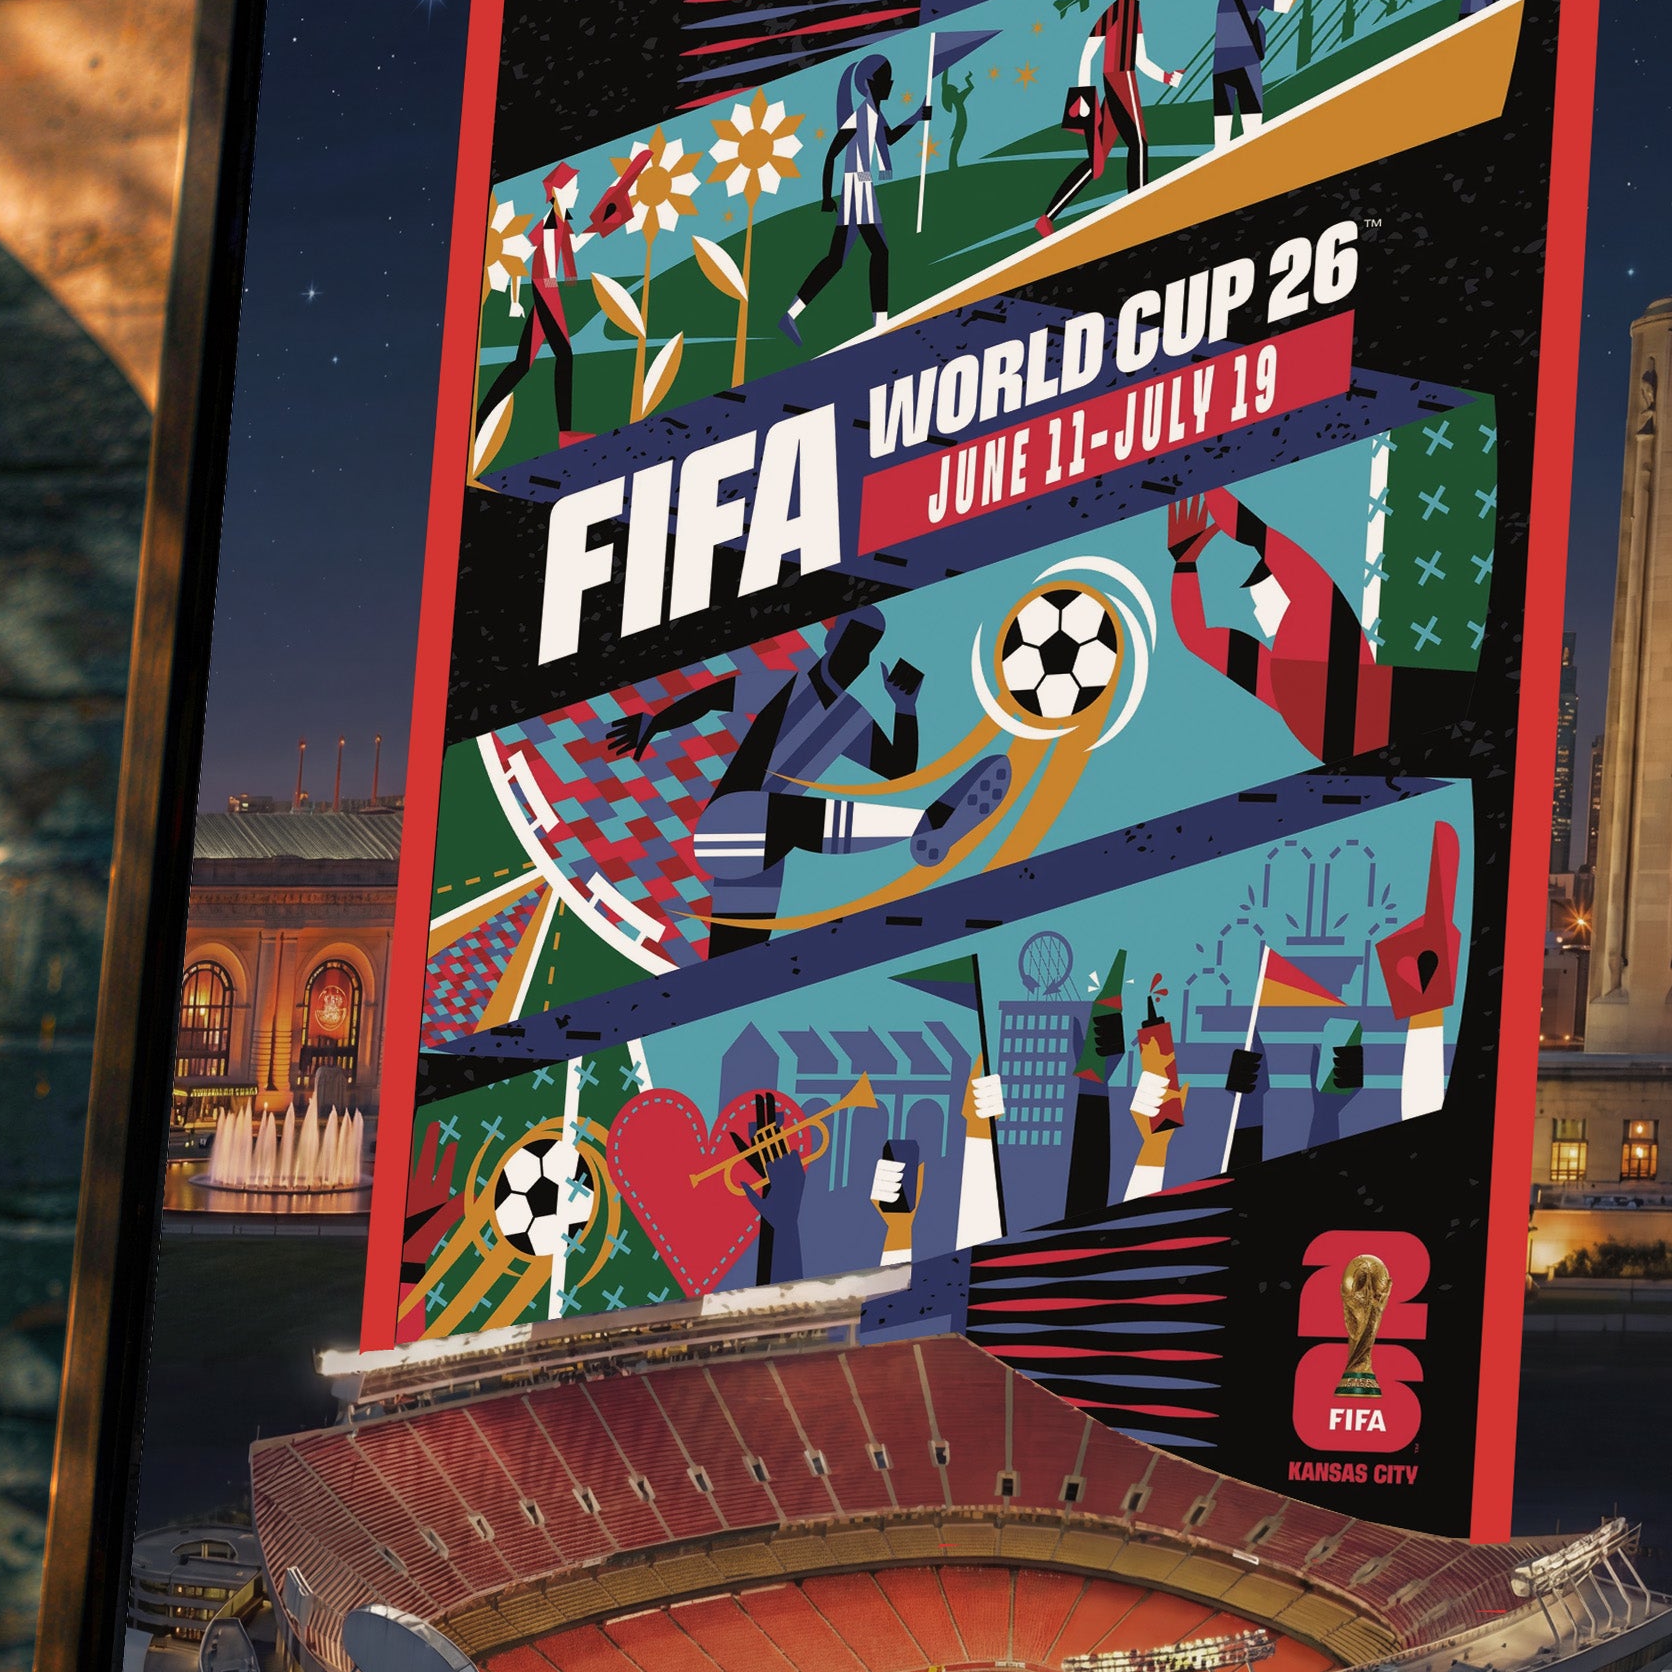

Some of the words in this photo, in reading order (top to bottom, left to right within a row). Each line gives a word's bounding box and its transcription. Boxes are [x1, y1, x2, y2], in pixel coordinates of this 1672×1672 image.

[869, 311, 1105, 459] WORLD
[1115, 257, 1255, 373] CUP
[1267, 220, 1358, 324] 26
[928, 427, 1030, 524] JUNE
[1045, 364, 1215, 485] 11-JULY
[1230, 344, 1277, 422] 19
[537, 402, 842, 666] FIFA
[1288, 1460, 1368, 1484] KANSAS
[1373, 1463, 1419, 1485] CITY
[1329, 1407, 1387, 1432] FIFA
